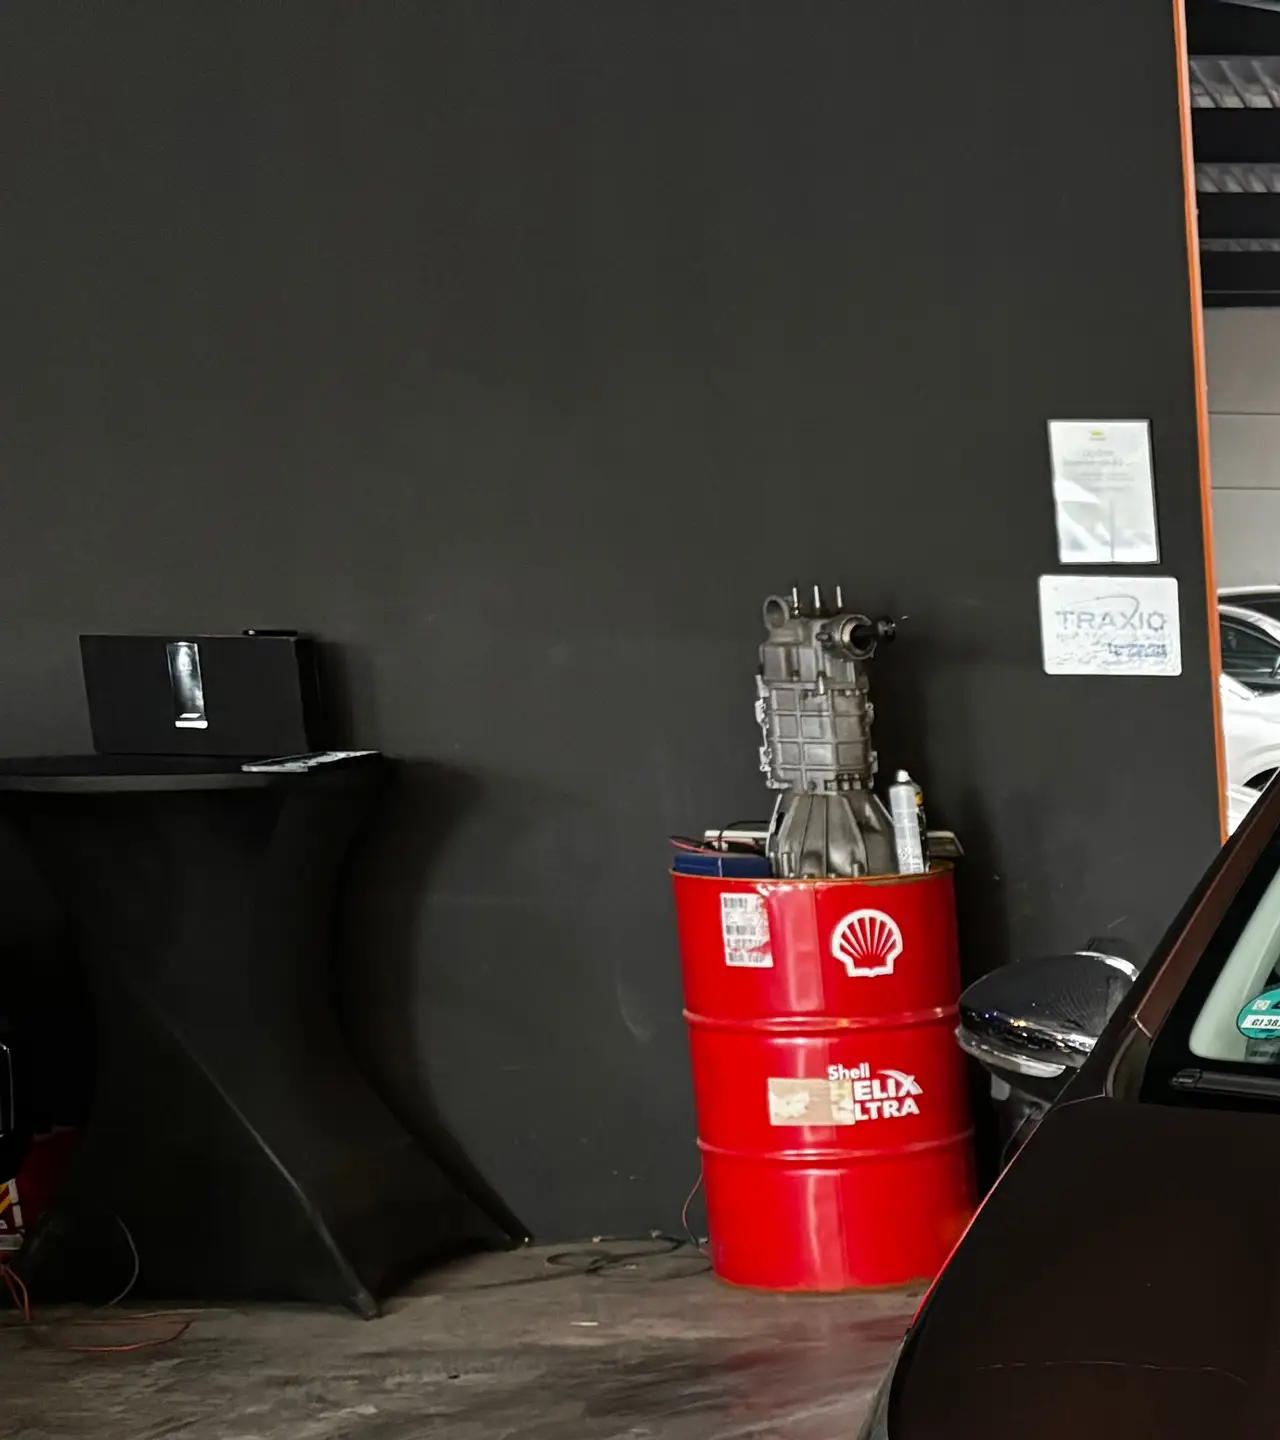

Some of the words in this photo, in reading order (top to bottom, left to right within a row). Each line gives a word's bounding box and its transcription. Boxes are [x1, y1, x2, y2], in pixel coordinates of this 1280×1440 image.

[1055, 609, 1168, 632] TRAXIO
[827, 1062, 870, 1081] Shell
[832, 1070, 923, 1101] ELIX
[834, 1097, 920, 1121] LTRA
